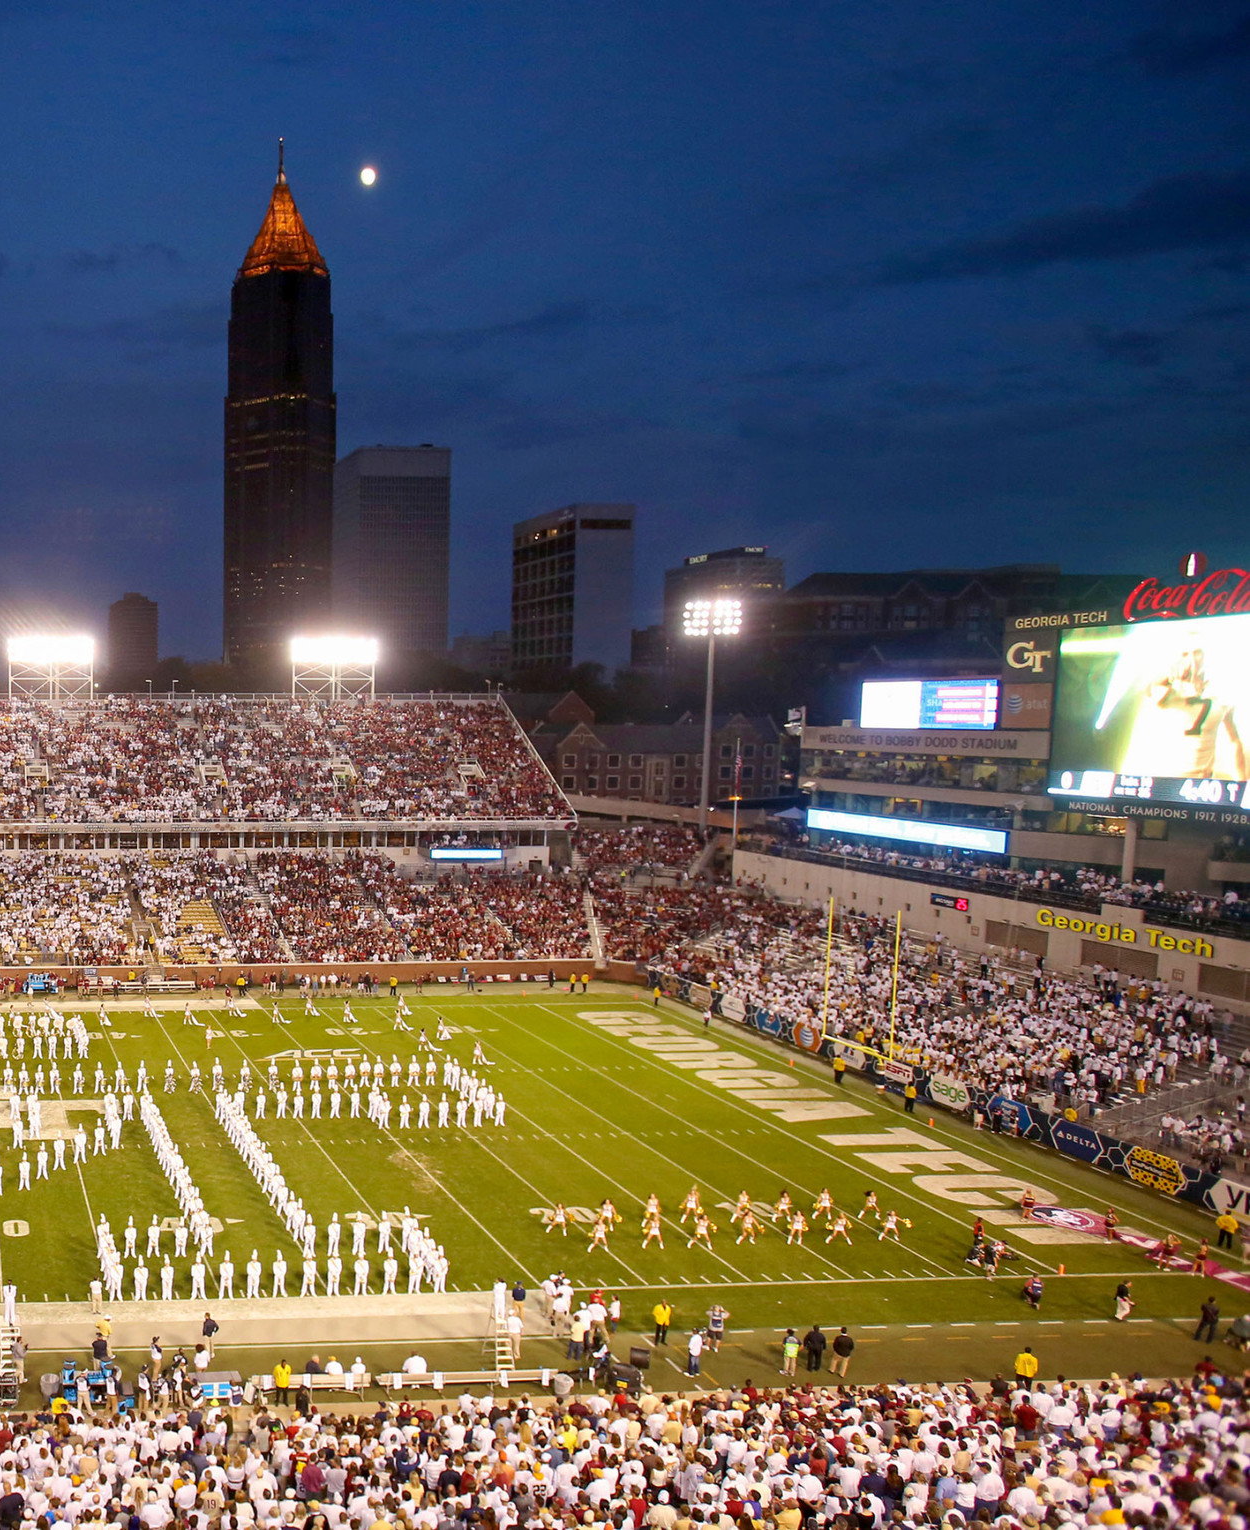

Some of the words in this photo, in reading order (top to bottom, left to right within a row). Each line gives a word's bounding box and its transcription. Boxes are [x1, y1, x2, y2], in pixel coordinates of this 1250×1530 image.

[1015, 614, 1070, 629] GEORGIA
[1073, 610, 1108, 625] TECH
[1006, 641, 1051, 673] GT
[819, 734, 866, 746] WELCOME
[869, 735, 883, 746] TO
[885, 735, 922, 747] BOBBY
[924, 736, 959, 748] DODD
[962, 737, 1018, 750] STADIUM
[1069, 801, 1117, 813] NATIONAL
[1122, 805, 1188, 819] CHAMPIONS
[955, 897, 969, 911] 25
[1036, 908, 1137, 943] Georgia
[1145, 928, 1214, 958] Tech
[263, 1048, 363, 1059] ACC
[576, 1010, 873, 1123] GEORGIA
[885, 1062, 911, 1079] ESPN
[932, 1081, 967, 1104] sage
[1065, 1132, 1097, 1151] DELTA
[817, 1127, 1120, 1247] TECH
[206, 1499, 217, 1509] 19
